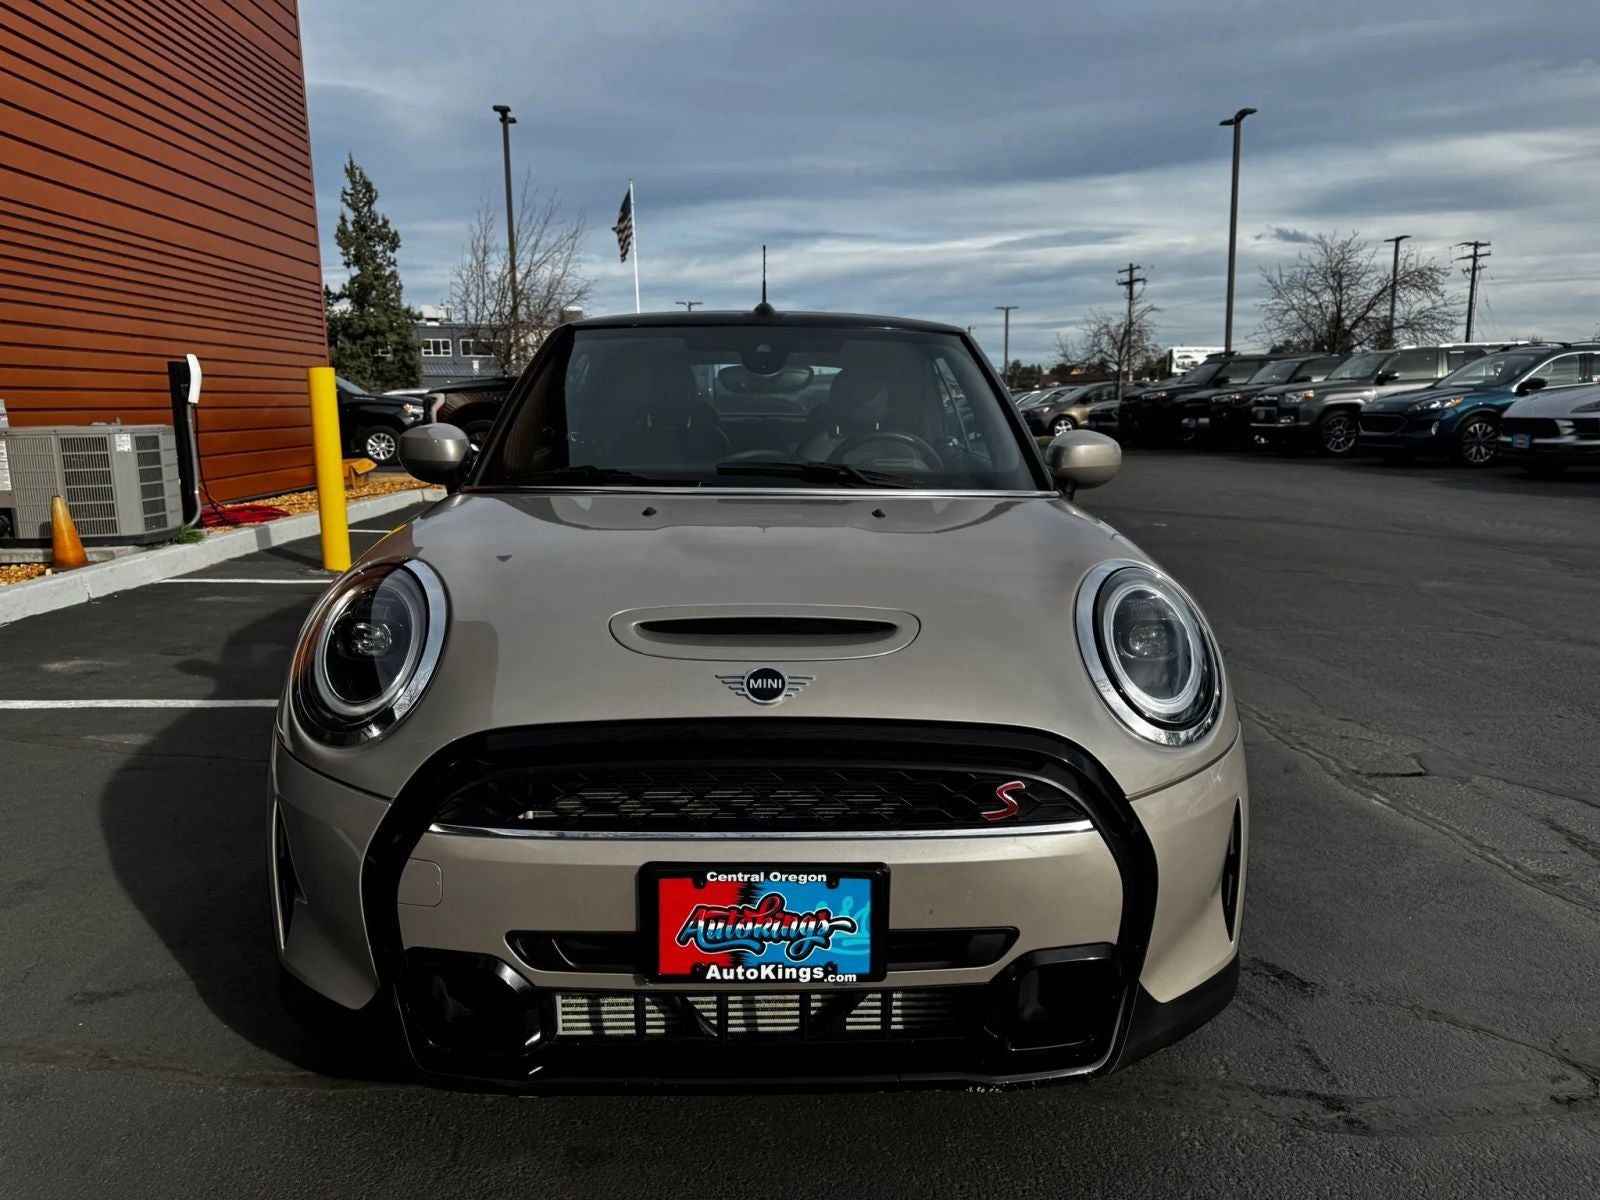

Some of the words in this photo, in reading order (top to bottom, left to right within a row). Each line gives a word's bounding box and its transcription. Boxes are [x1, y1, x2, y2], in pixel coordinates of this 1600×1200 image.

[749, 679, 782, 689] MINI
[980, 780, 1026, 821] S
[706, 871, 765, 882] Central
[769, 871, 827, 885] Oregon
[705, 964, 857, 983] AutoKings.com
